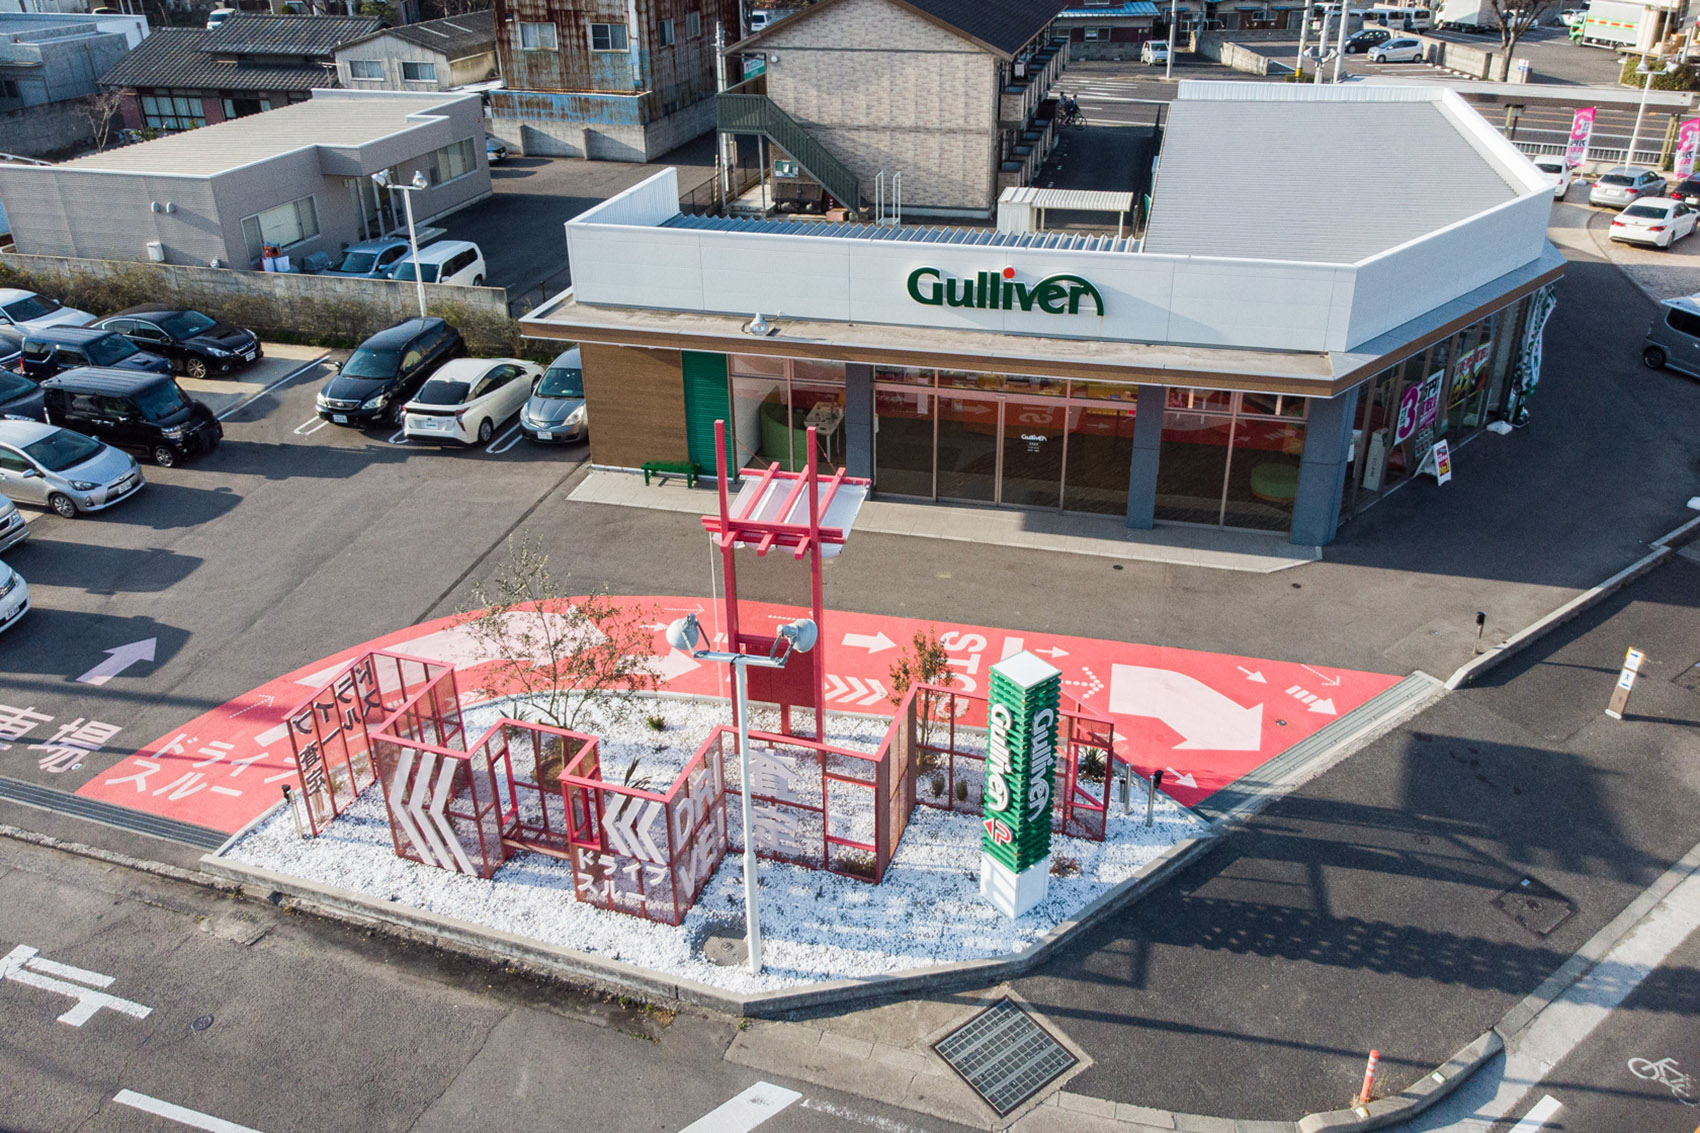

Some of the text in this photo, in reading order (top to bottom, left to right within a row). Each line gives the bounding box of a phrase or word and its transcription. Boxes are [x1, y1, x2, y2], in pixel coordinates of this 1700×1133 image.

[907, 266, 1104, 316] Gulliver
[1398, 385, 1419, 439] 3
[105, 759, 243, 800] スルー
[988, 703, 1014, 812] Gulliver
[1027, 708, 1055, 822] Gulliver
[577, 873, 646, 901] スルー
[578, 848, 668, 886] ドライブ
